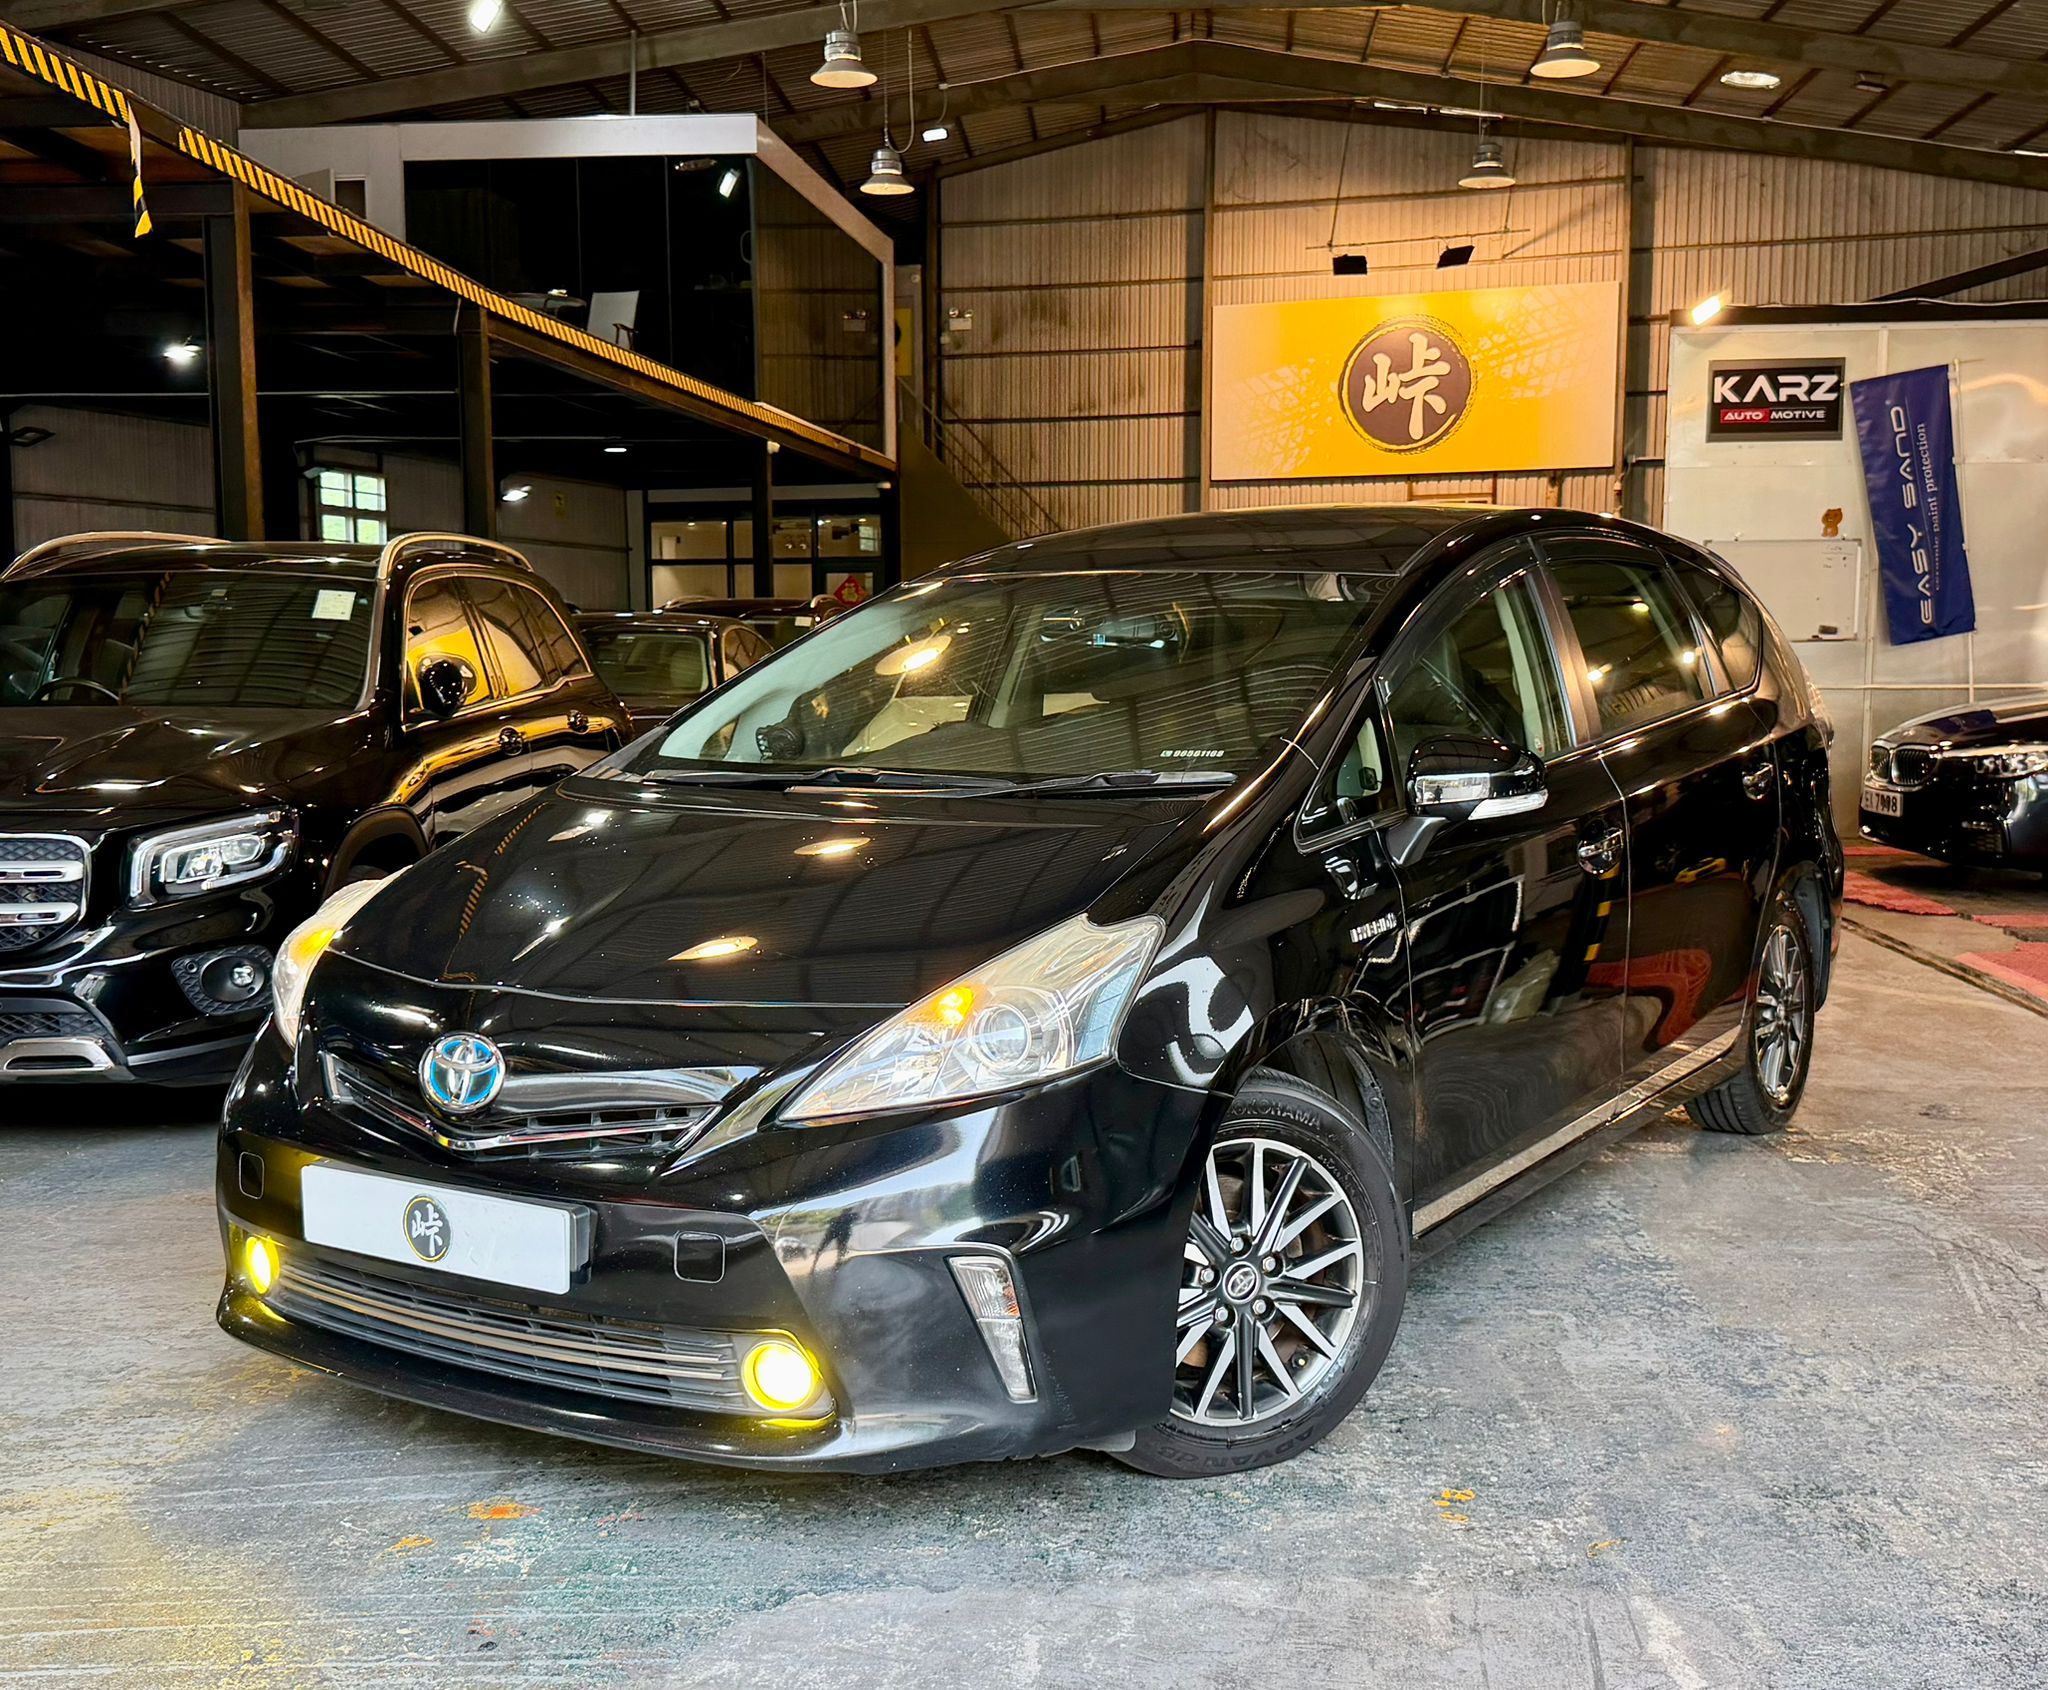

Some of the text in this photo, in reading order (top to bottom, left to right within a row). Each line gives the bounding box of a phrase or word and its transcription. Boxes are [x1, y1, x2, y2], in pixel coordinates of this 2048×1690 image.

[1362, 332, 1451, 440] 峠
[1713, 374, 1839, 403] KARZ
[1723, 410, 1826, 421] AUTO MOTIVE
[1917, 423, 1938, 493] protection
[1890, 406, 1932, 624] EASY SAND
[1927, 497, 1941, 533] paint
[411, 1202, 443, 1257] 峠
